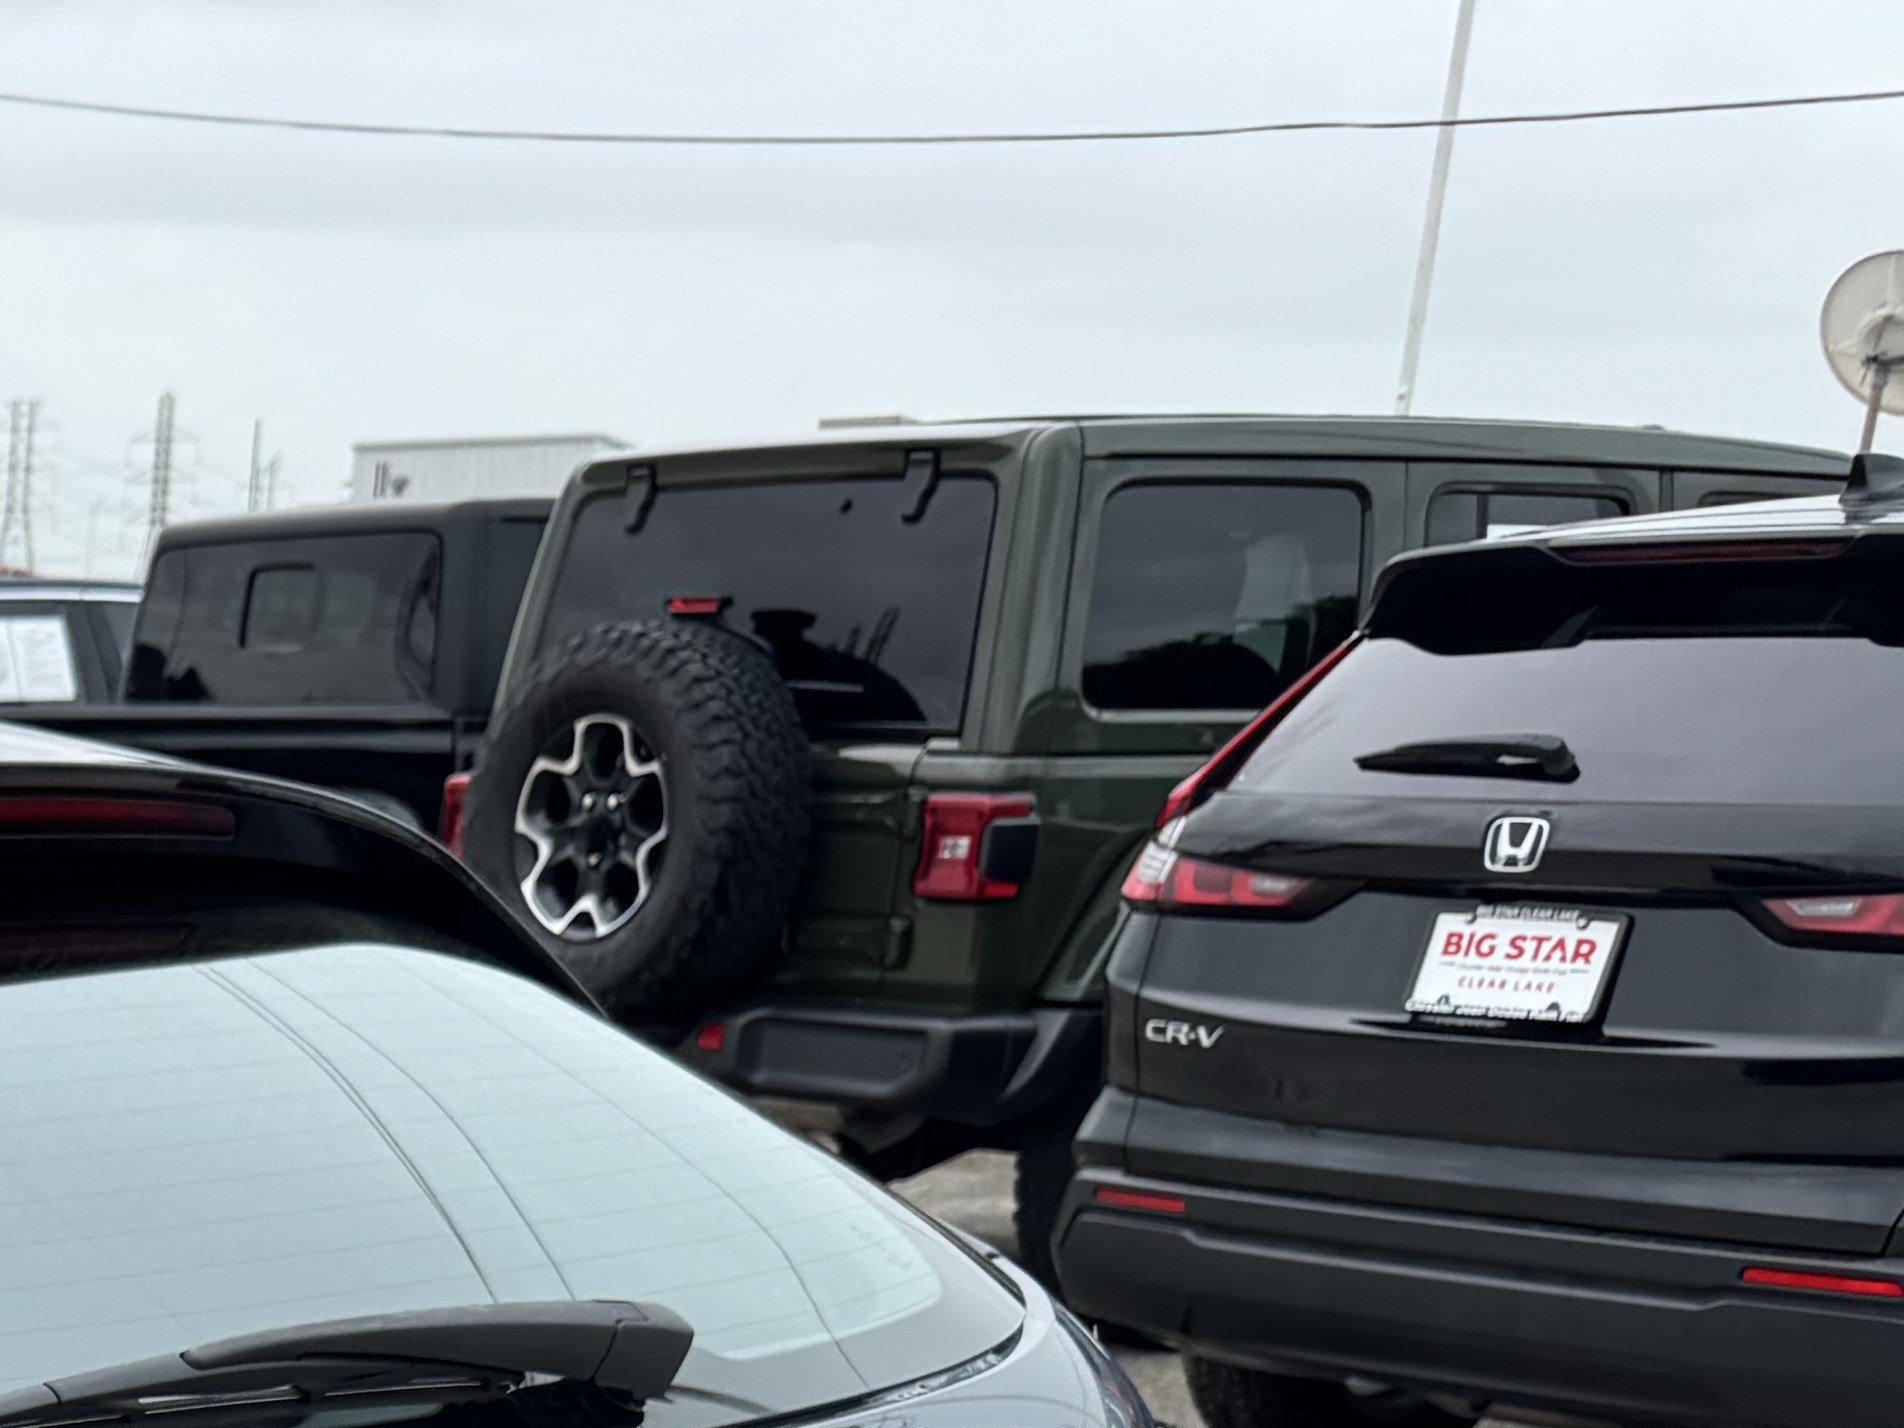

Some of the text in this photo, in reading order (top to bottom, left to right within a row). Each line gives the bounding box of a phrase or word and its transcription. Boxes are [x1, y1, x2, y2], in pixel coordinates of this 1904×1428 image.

[1441, 930, 1597, 965] BIG STAR
[1458, 975, 1556, 993] CLEAR LAKE
[1145, 1018, 1226, 1049] CR-V
